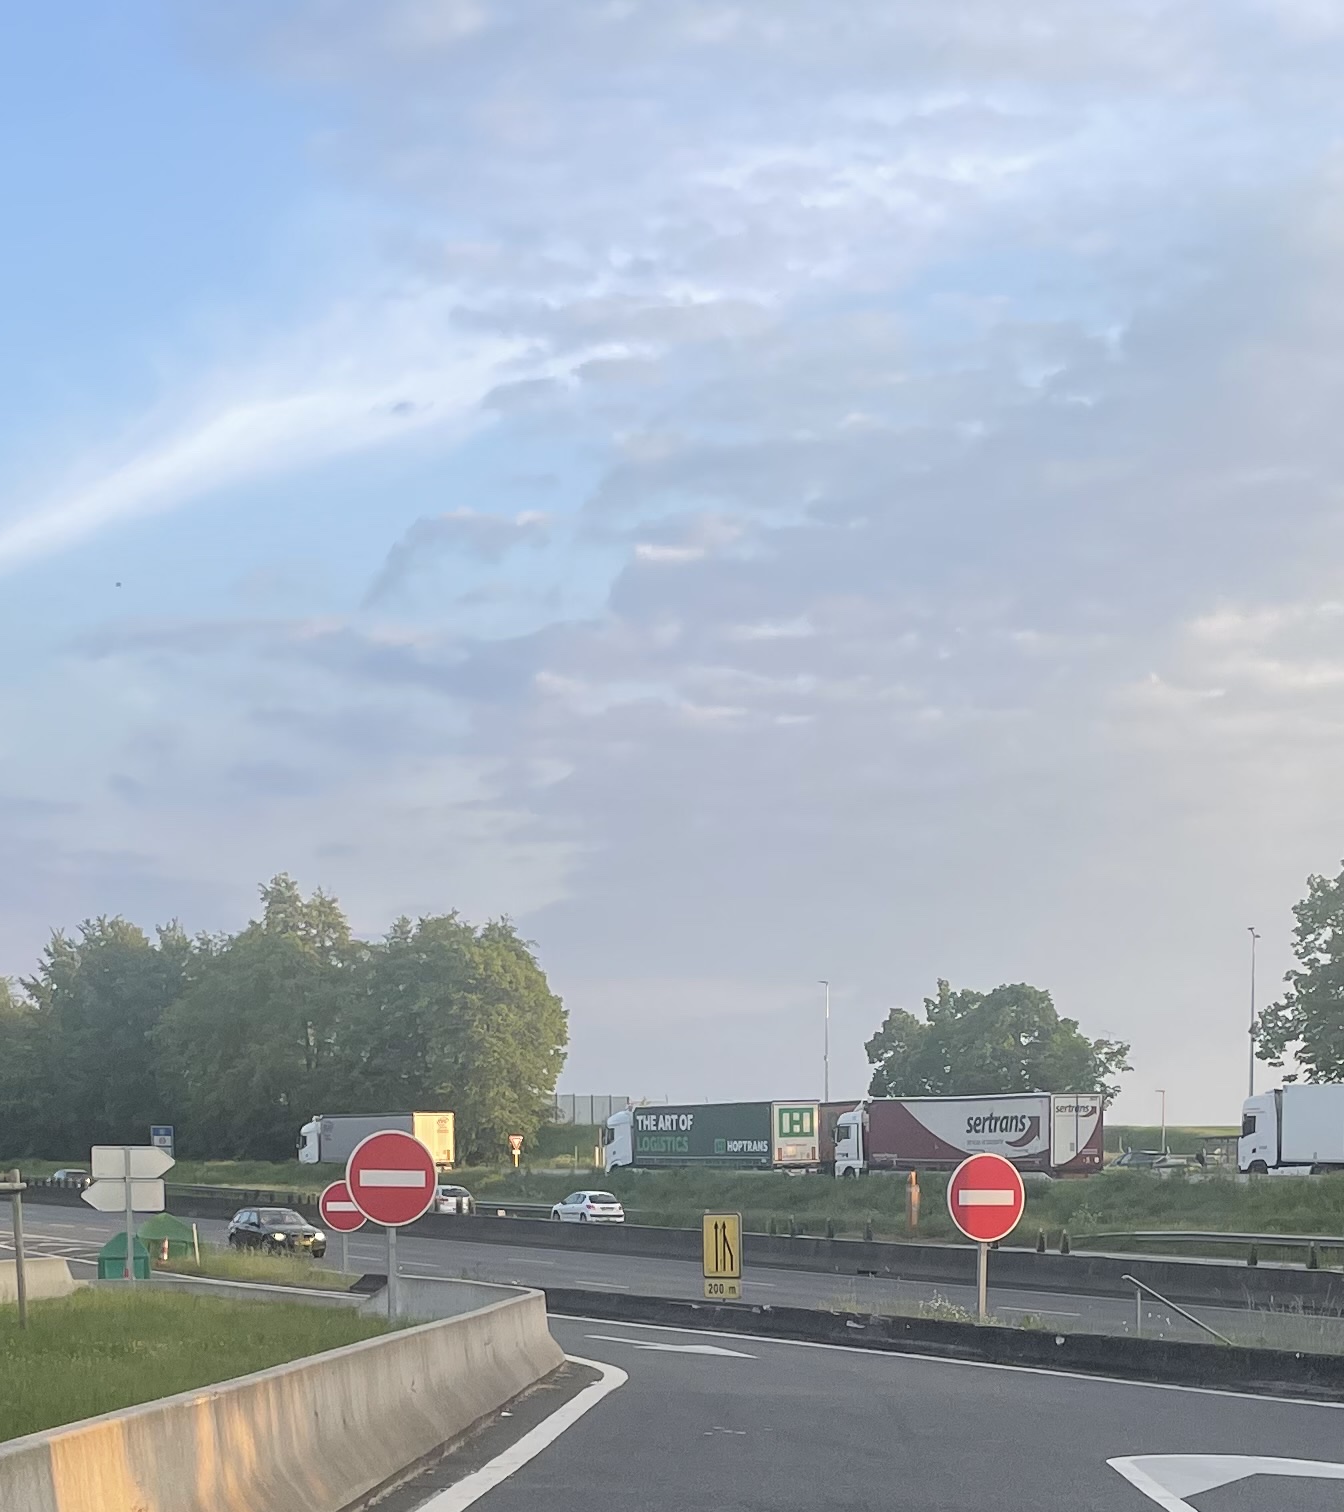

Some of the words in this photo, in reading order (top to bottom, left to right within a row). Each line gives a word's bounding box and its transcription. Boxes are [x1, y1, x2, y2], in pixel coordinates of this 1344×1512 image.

[1056, 1104, 1090, 1113] sertrans
[636, 1114, 657, 1131] THE
[658, 1114, 678, 1131] ART
[679, 1114, 694, 1131] OF
[966, 1112, 1026, 1134] sertrans
[636, 1136, 689, 1152] LOGISTICS
[726, 1140, 769, 1152] HOPTRANS
[708, 1283, 725, 1295] 200
[728, 1286, 737, 1295] m
